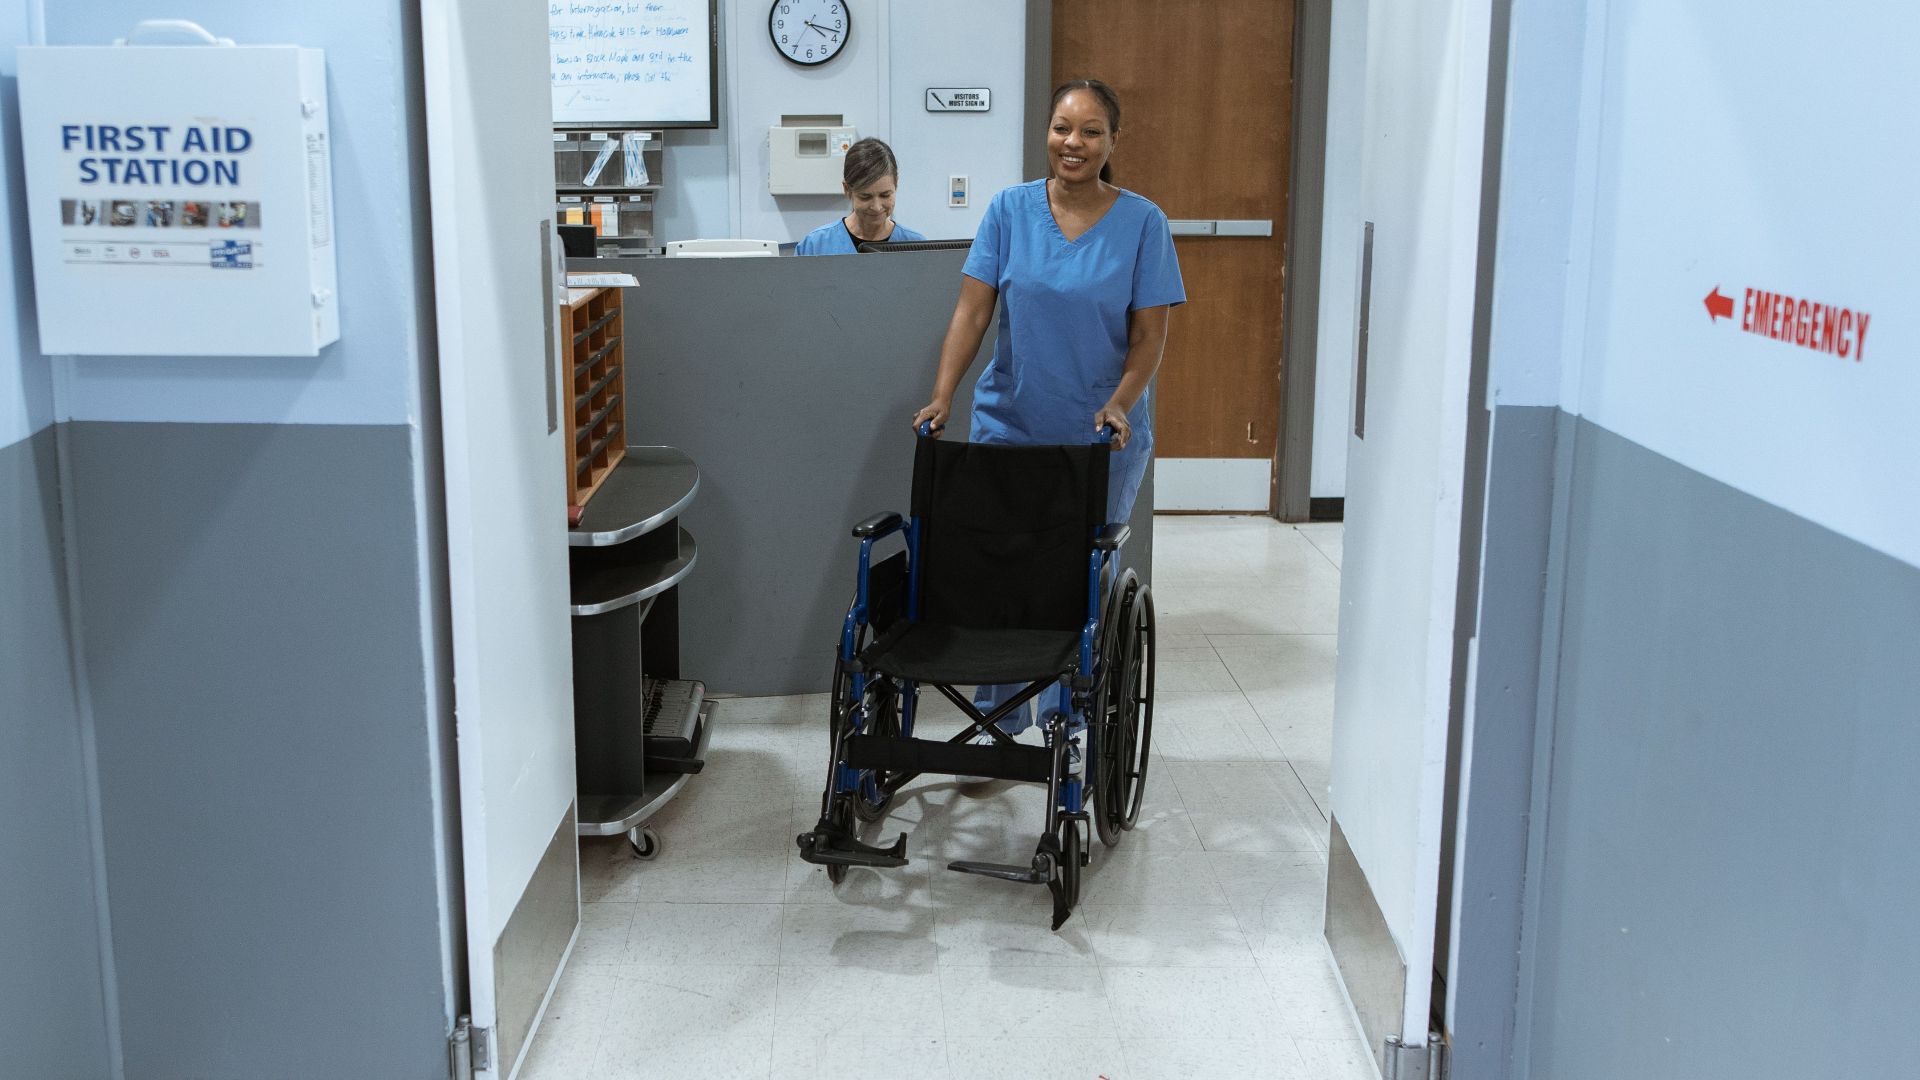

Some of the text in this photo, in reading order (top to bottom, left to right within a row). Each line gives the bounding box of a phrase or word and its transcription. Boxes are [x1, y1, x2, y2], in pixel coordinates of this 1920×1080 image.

[780, 5, 790, 15] 10
[831, 5, 838, 15] 2
[777, 20, 784, 29] 9
[835, 20, 842, 29] 3
[781, 34, 788, 44] 8
[831, 35, 838, 44] 4
[792, 45, 798, 55] 7
[806, 49, 813, 58] 6
[820, 45, 827, 54] 5
[61, 124, 252, 154] FIRST AID
[79, 158, 239, 186] STATION
[1742, 287, 1871, 362] EMERGENCY
